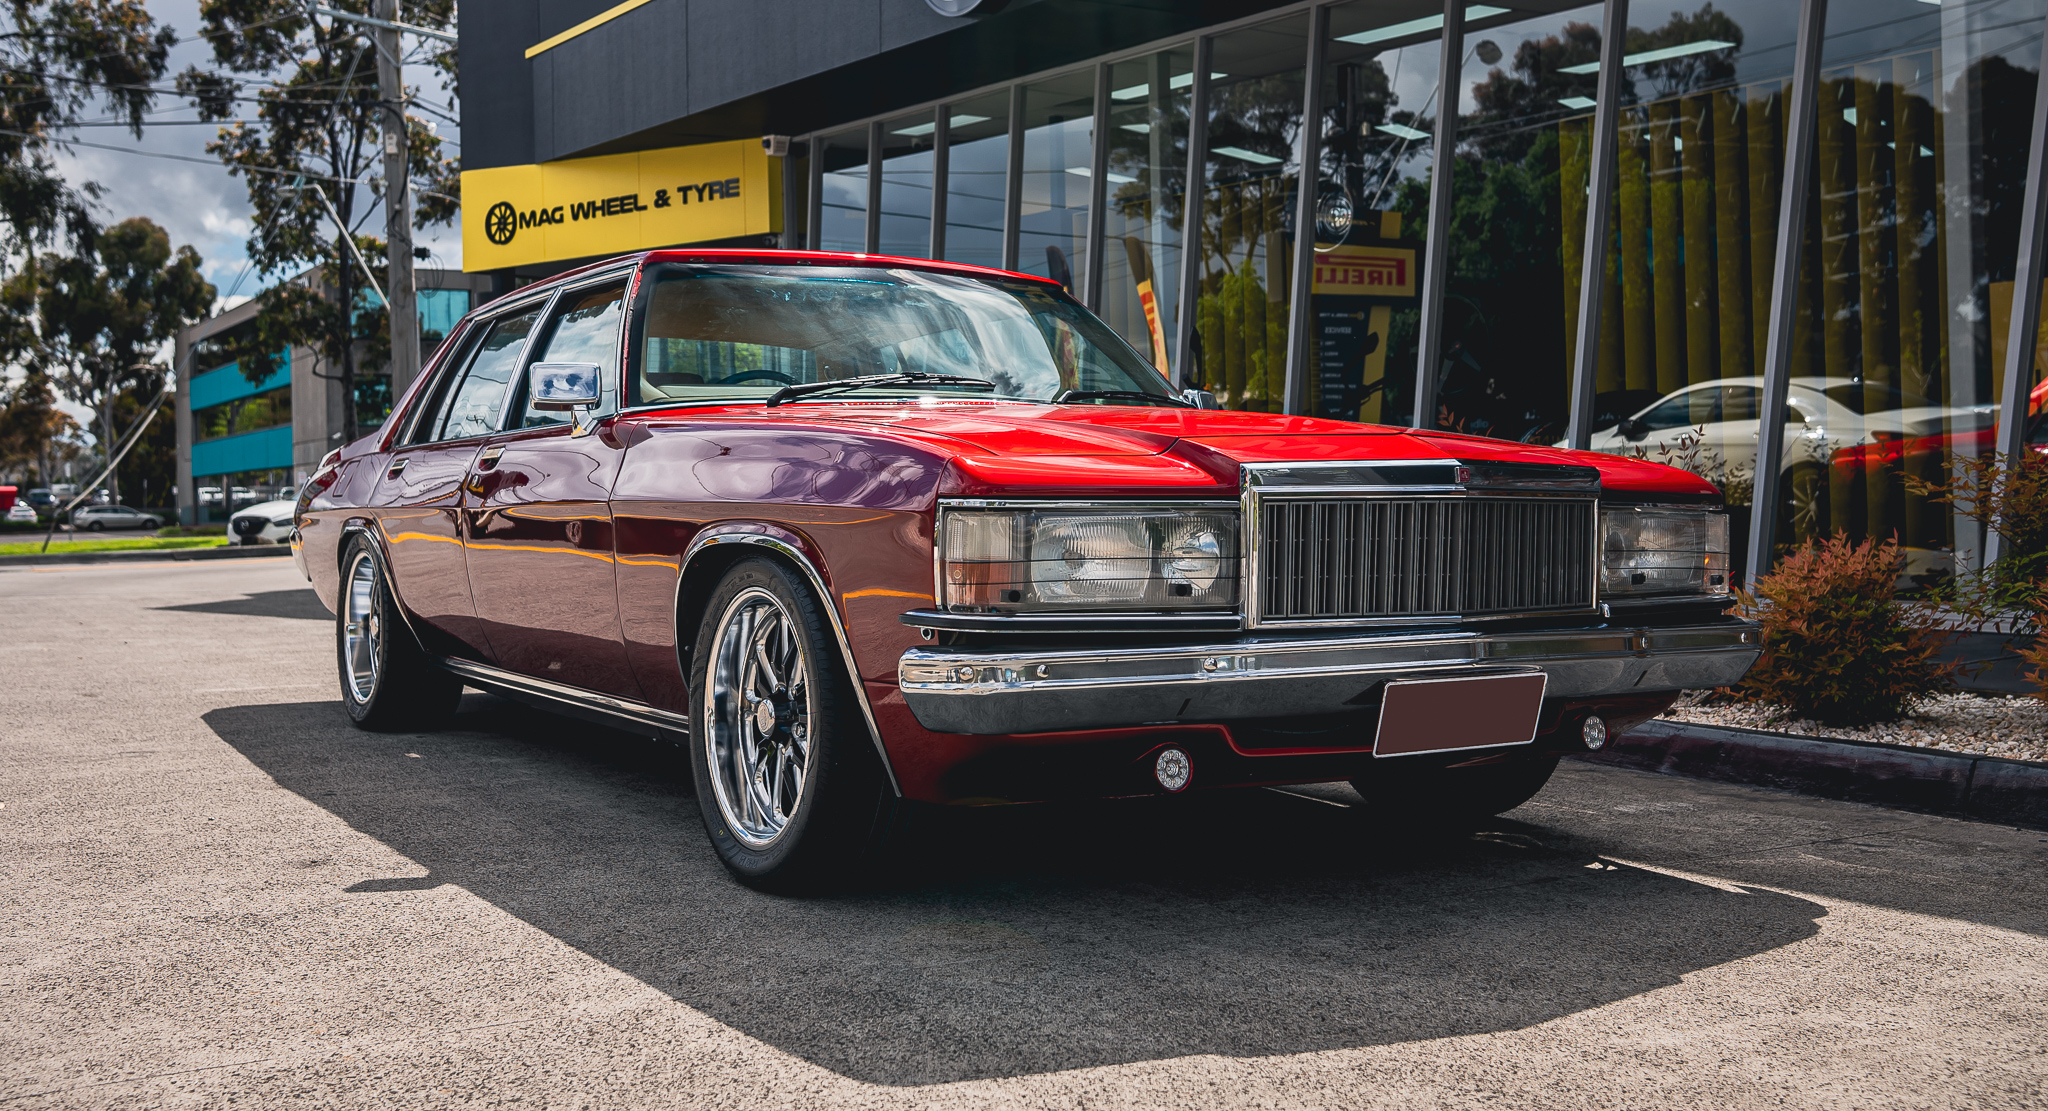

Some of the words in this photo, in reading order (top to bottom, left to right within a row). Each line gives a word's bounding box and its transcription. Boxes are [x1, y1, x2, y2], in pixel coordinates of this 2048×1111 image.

[518, 205, 565, 230] MAG
[570, 193, 648, 221] WHEEL
[654, 188, 671, 208] &
[677, 177, 740, 205] TYRE
